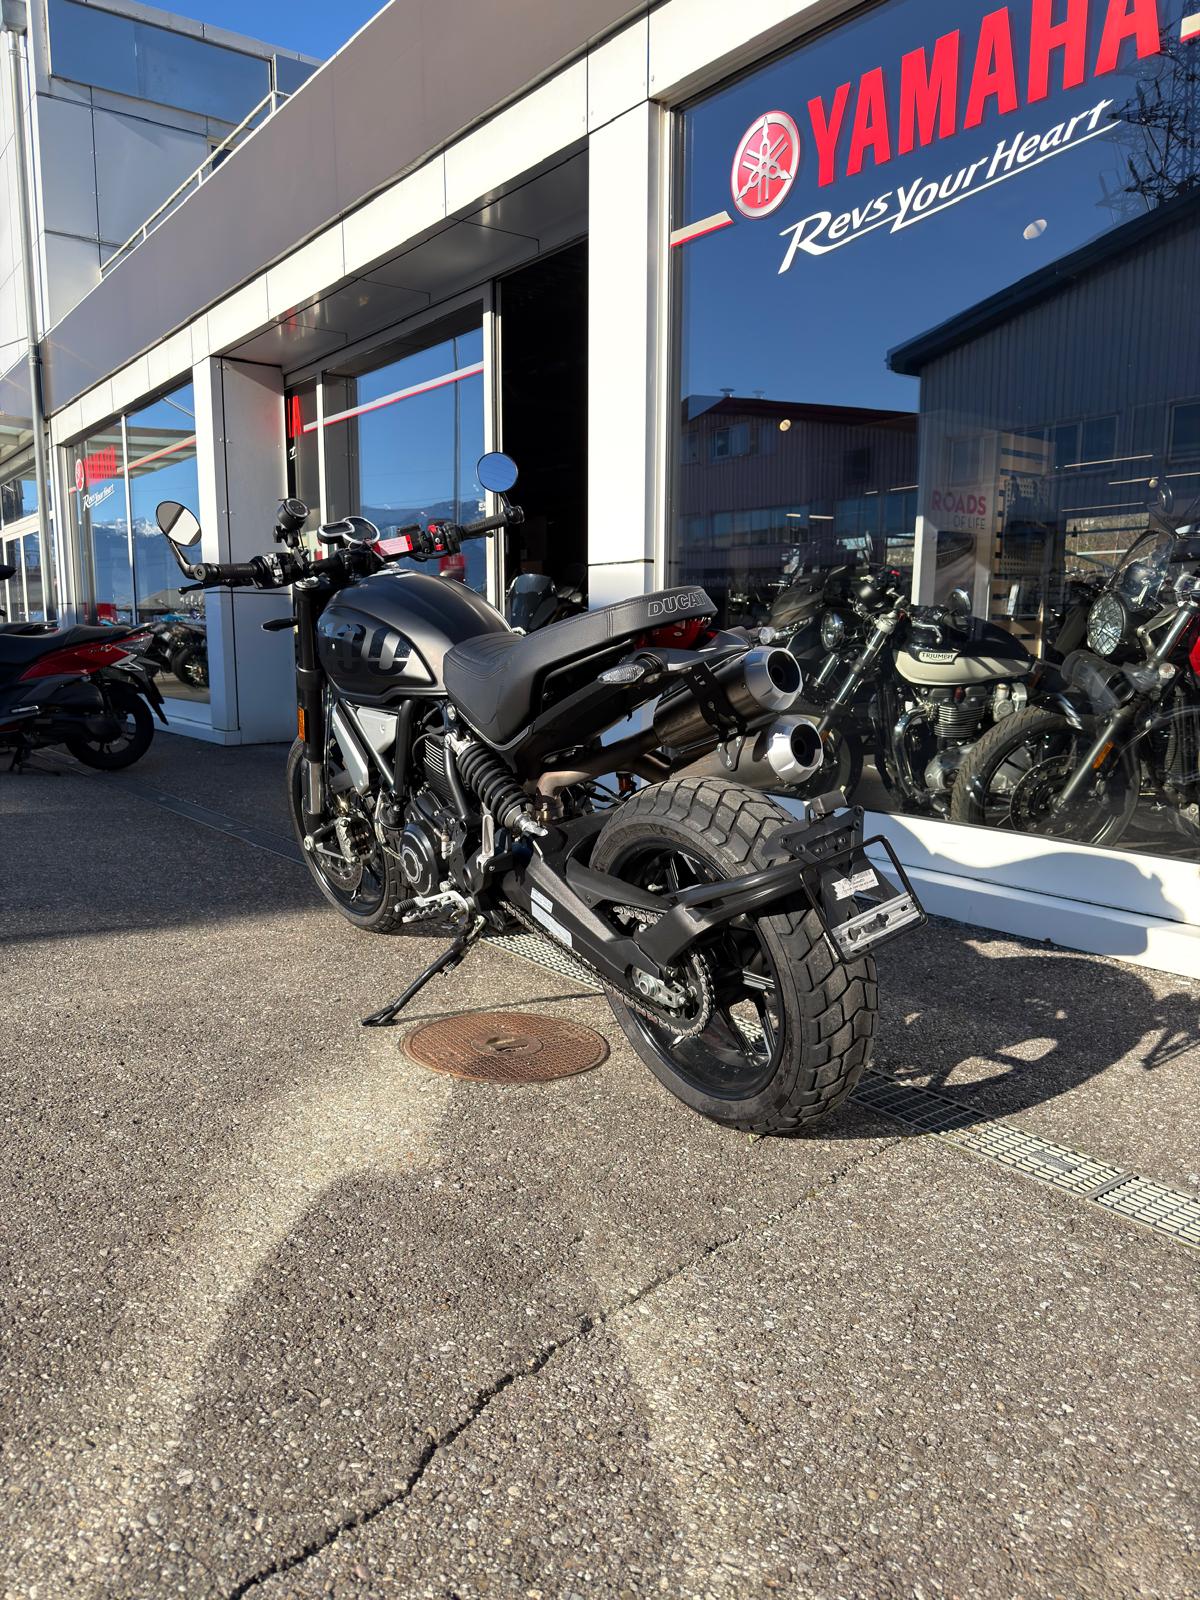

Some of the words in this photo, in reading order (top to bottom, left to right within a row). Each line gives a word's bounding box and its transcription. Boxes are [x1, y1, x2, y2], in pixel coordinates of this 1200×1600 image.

[806, 0, 1161, 188] YAMAHA
[777, 190, 895, 275] Revs
[890, 157, 989, 234] Your
[985, 98, 1115, 181] Heart
[931, 489, 987, 516] ROADS
[953, 515, 967, 528] OF
[967, 516, 986, 530] LIFE
[647, 591, 706, 617] DUCAT
[921, 652, 954, 660] TRIUMPH
